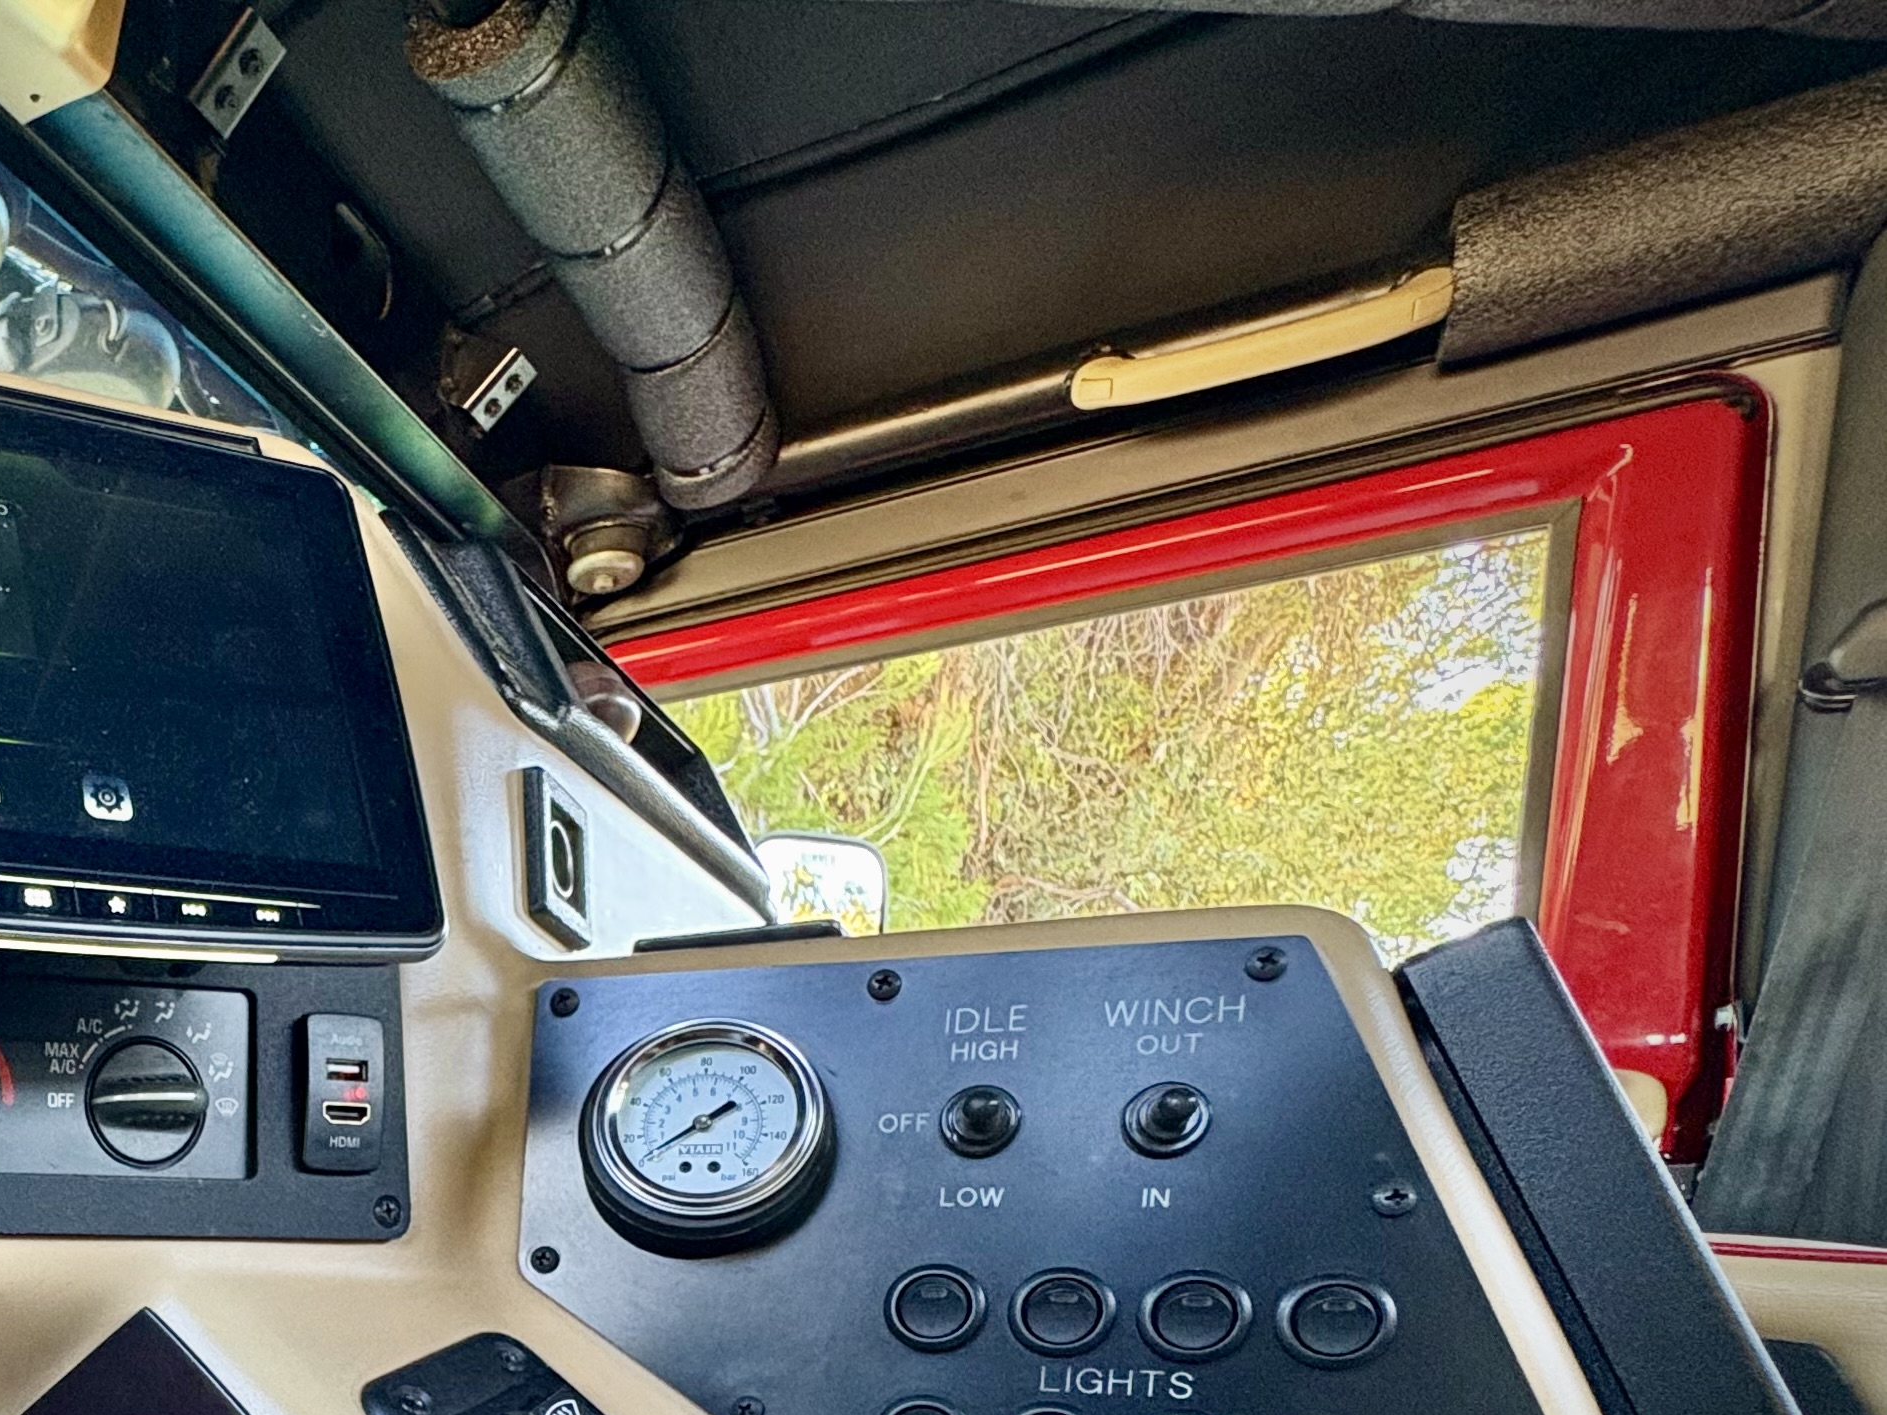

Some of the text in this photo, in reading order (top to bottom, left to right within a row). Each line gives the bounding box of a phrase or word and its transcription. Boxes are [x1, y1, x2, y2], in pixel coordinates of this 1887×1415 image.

[944, 1004, 1029, 1036] IDLE
[1104, 994, 1247, 1029] WINCH
[76, 1018, 103, 1036] A/C
[44, 1041, 80, 1059] MAX
[950, 1040, 1020, 1063] HIGH
[1136, 1033, 1204, 1056] OUT
[49, 1058, 77, 1075] A/C
[700, 1057, 713, 1067] 80
[739, 1065, 757, 1075] 100
[47, 1093, 75, 1109] OFF
[767, 1094, 785, 1105] 120
[877, 1112, 931, 1135] OFF
[329, 1135, 361, 1149] HDMI
[769, 1131, 787, 1141] 140
[678, 1144, 723, 1155] VIAIR
[939, 1186, 1005, 1208] LOW
[1141, 1187, 1172, 1209] IN
[1039, 1365, 1195, 1400] LIGHTS
